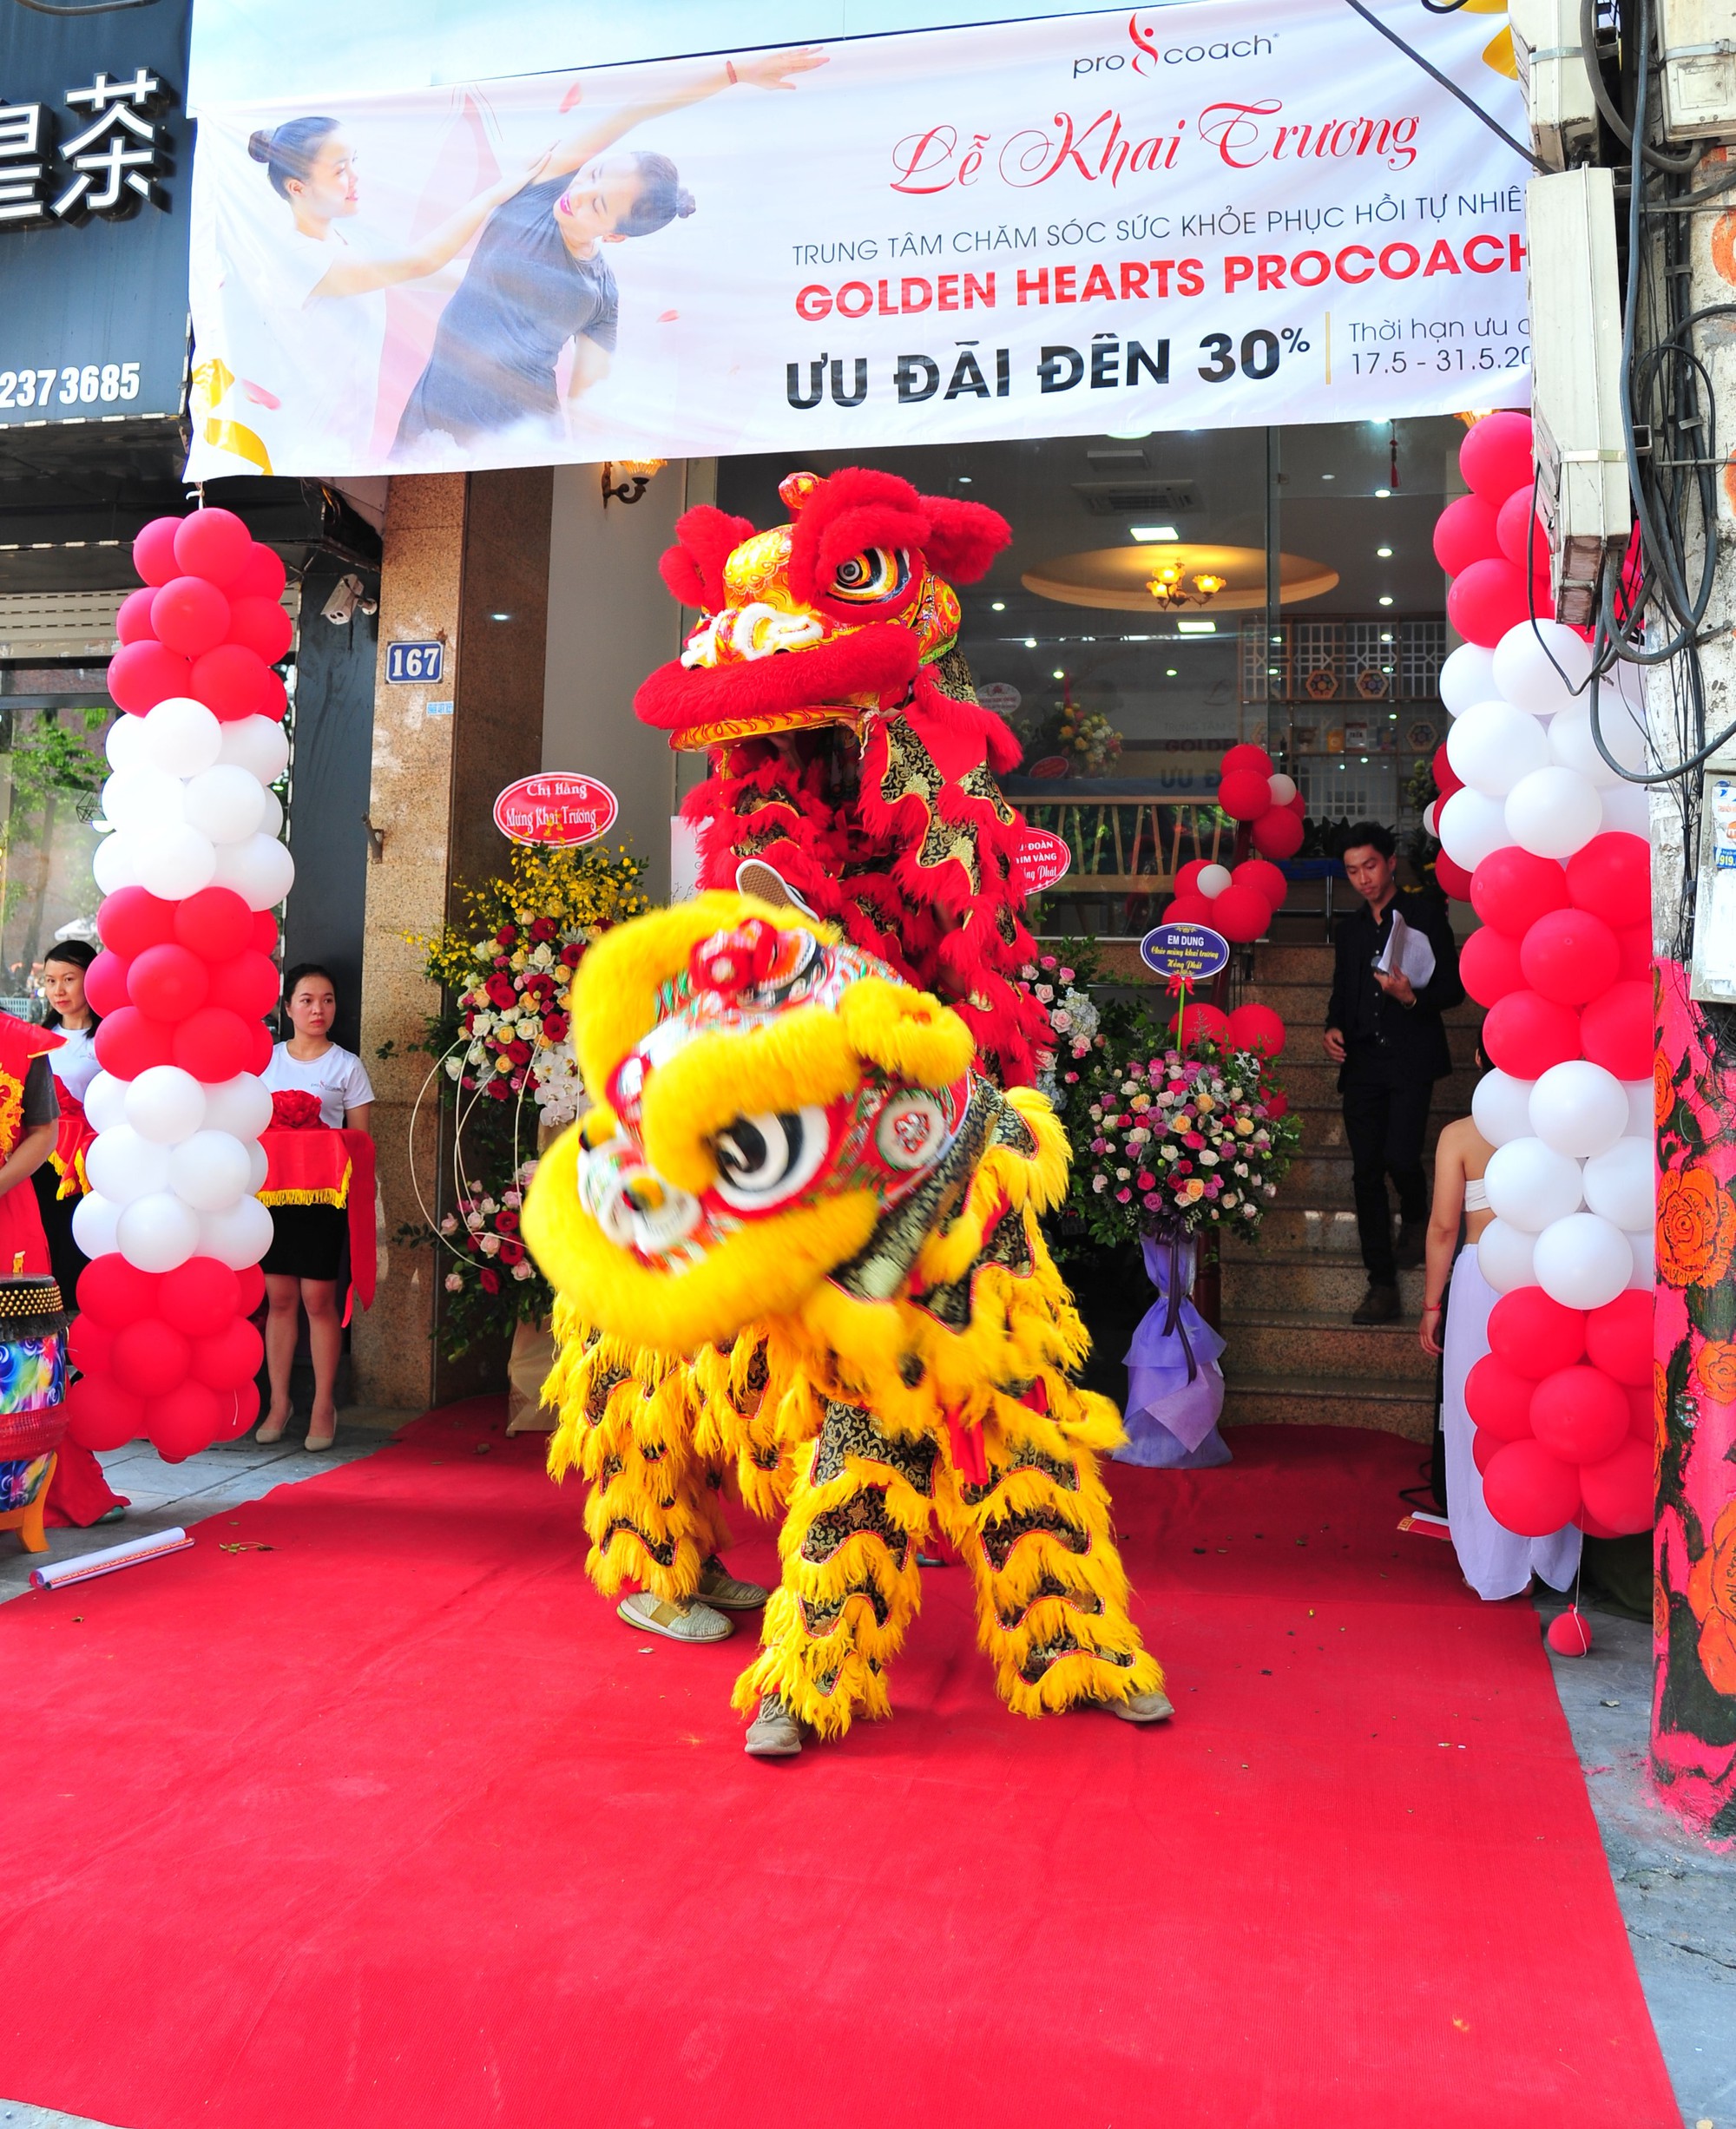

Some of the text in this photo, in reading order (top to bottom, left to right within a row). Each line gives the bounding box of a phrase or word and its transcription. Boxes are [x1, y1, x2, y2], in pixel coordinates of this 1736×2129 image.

[1073, 55, 1125, 79] pro
[890, 98, 1420, 194] Lễ Khai Trương
[792, 185, 1526, 266] TRUNG TÂM CHĂM SÓC SỨC KHỎE PHỤC HỒI TỰ NHIÊ
[795, 272, 996, 321] GOLDEN
[1016, 258, 1205, 306] HEARTS
[1348, 319, 1402, 343] Thời
[1410, 318, 1464, 344] hạn
[1475, 318, 1508, 338] ưu
[786, 352, 868, 410] ƯU
[1198, 327, 1310, 384] 30%
[1352, 352, 1408, 375] 17.5
[59, 362, 141, 404] 3685
[392, 648, 440, 677] 167
[526, 783, 550, 798] Chị
[506, 807, 534, 834] Mừng
[1028, 839, 1053, 851] ĐOÀN
[1033, 852, 1057, 863] VÀNG
[1167, 935, 1204, 947] EM DUNG
